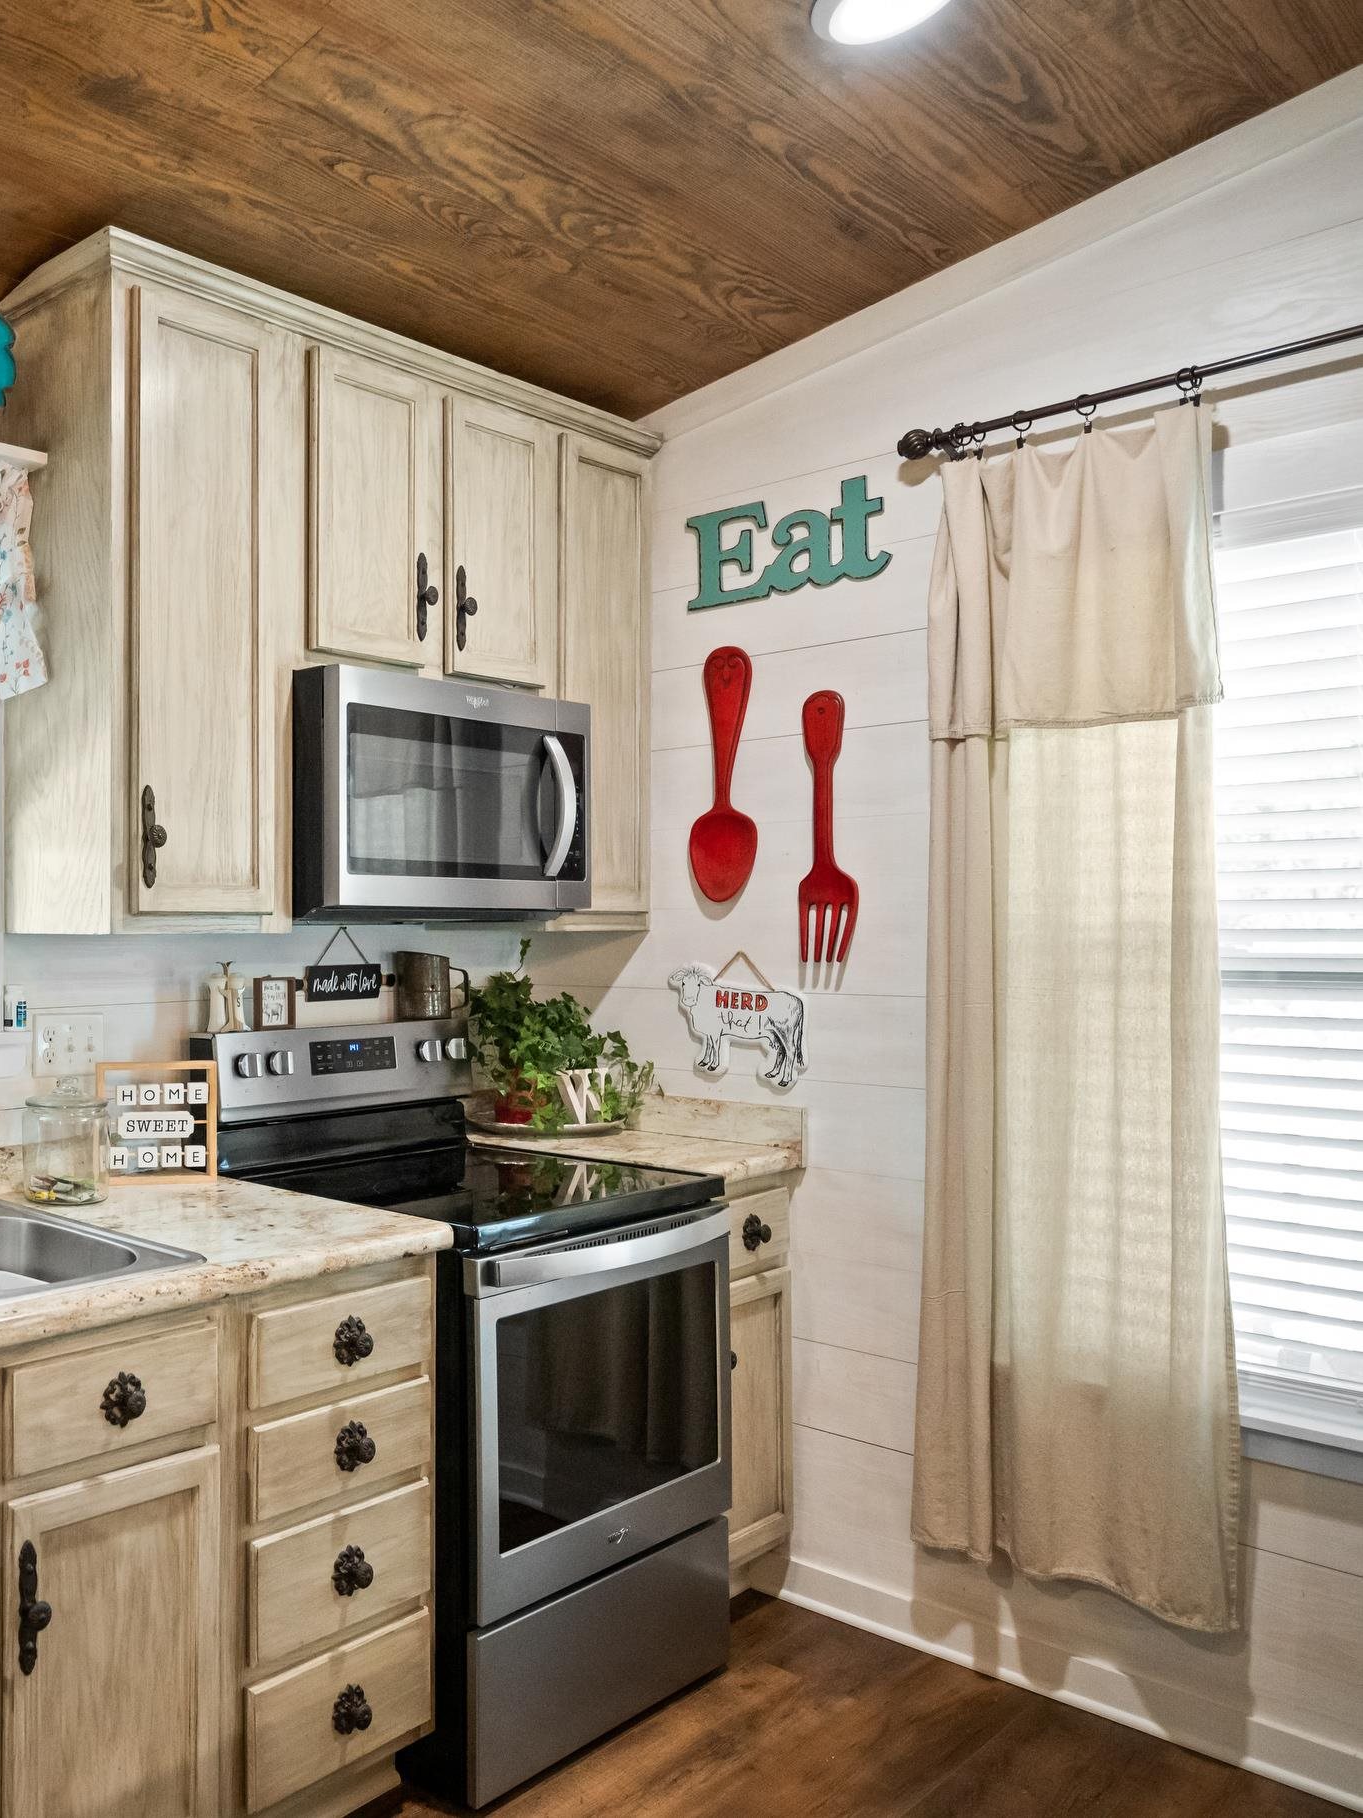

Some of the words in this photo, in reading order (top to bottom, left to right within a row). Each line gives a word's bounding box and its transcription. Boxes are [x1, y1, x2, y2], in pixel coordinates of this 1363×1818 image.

[687, 475, 893, 611] Eat
[312, 970, 339, 993] made
[340, 972, 358, 992] with
[359, 969, 377, 993] love
[715, 990, 768, 1012] HERD
[122, 1088, 203, 1102] HOME
[126, 1119, 189, 1133] SWEET
[113, 1151, 200, 1166] HOME
